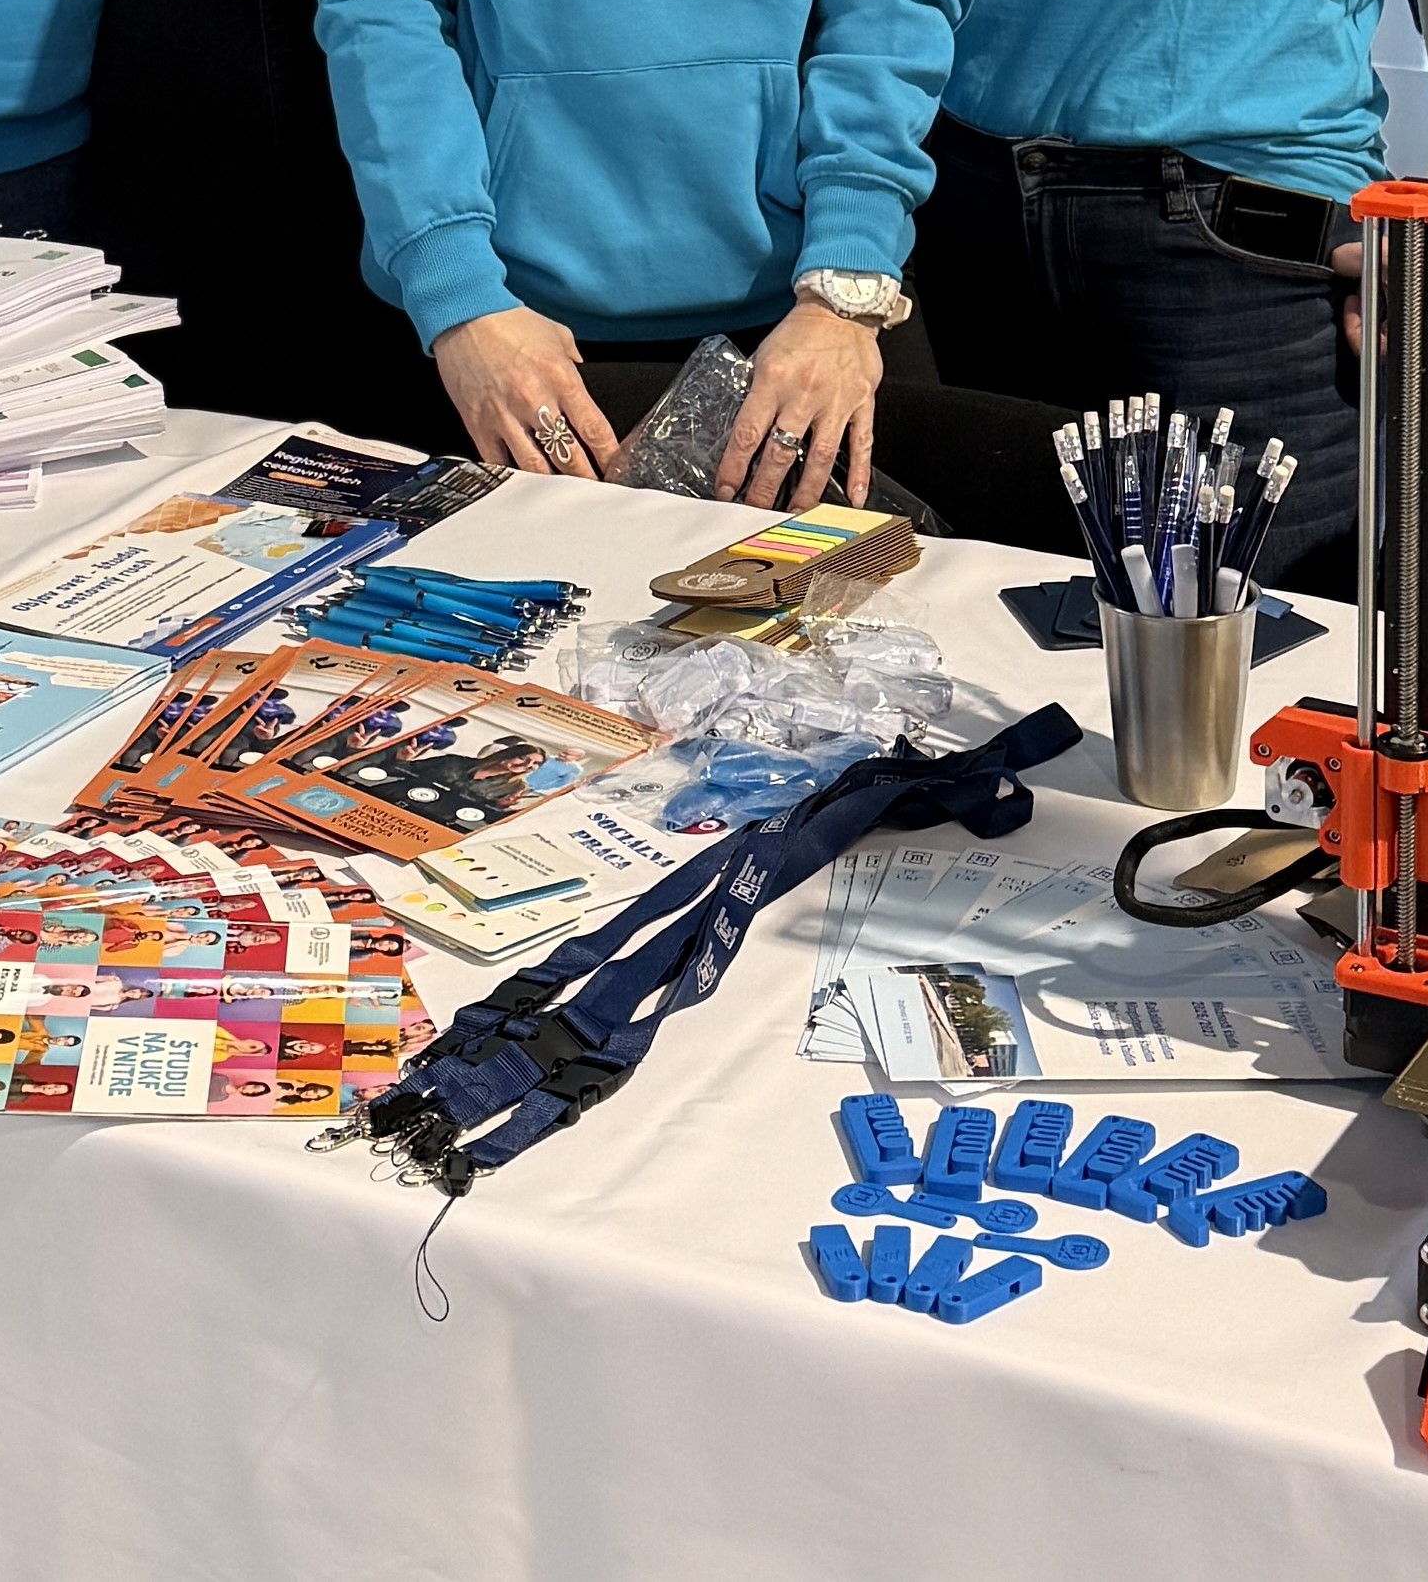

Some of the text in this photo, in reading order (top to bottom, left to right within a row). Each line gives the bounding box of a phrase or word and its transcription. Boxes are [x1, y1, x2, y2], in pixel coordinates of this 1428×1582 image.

[568, 830, 632, 870] PRÁCA
[109, 1036, 140, 1097] V NITRE
[138, 1031, 167, 1091] NA UKF
[156, 1039, 198, 1098] ŠTUDUJ
